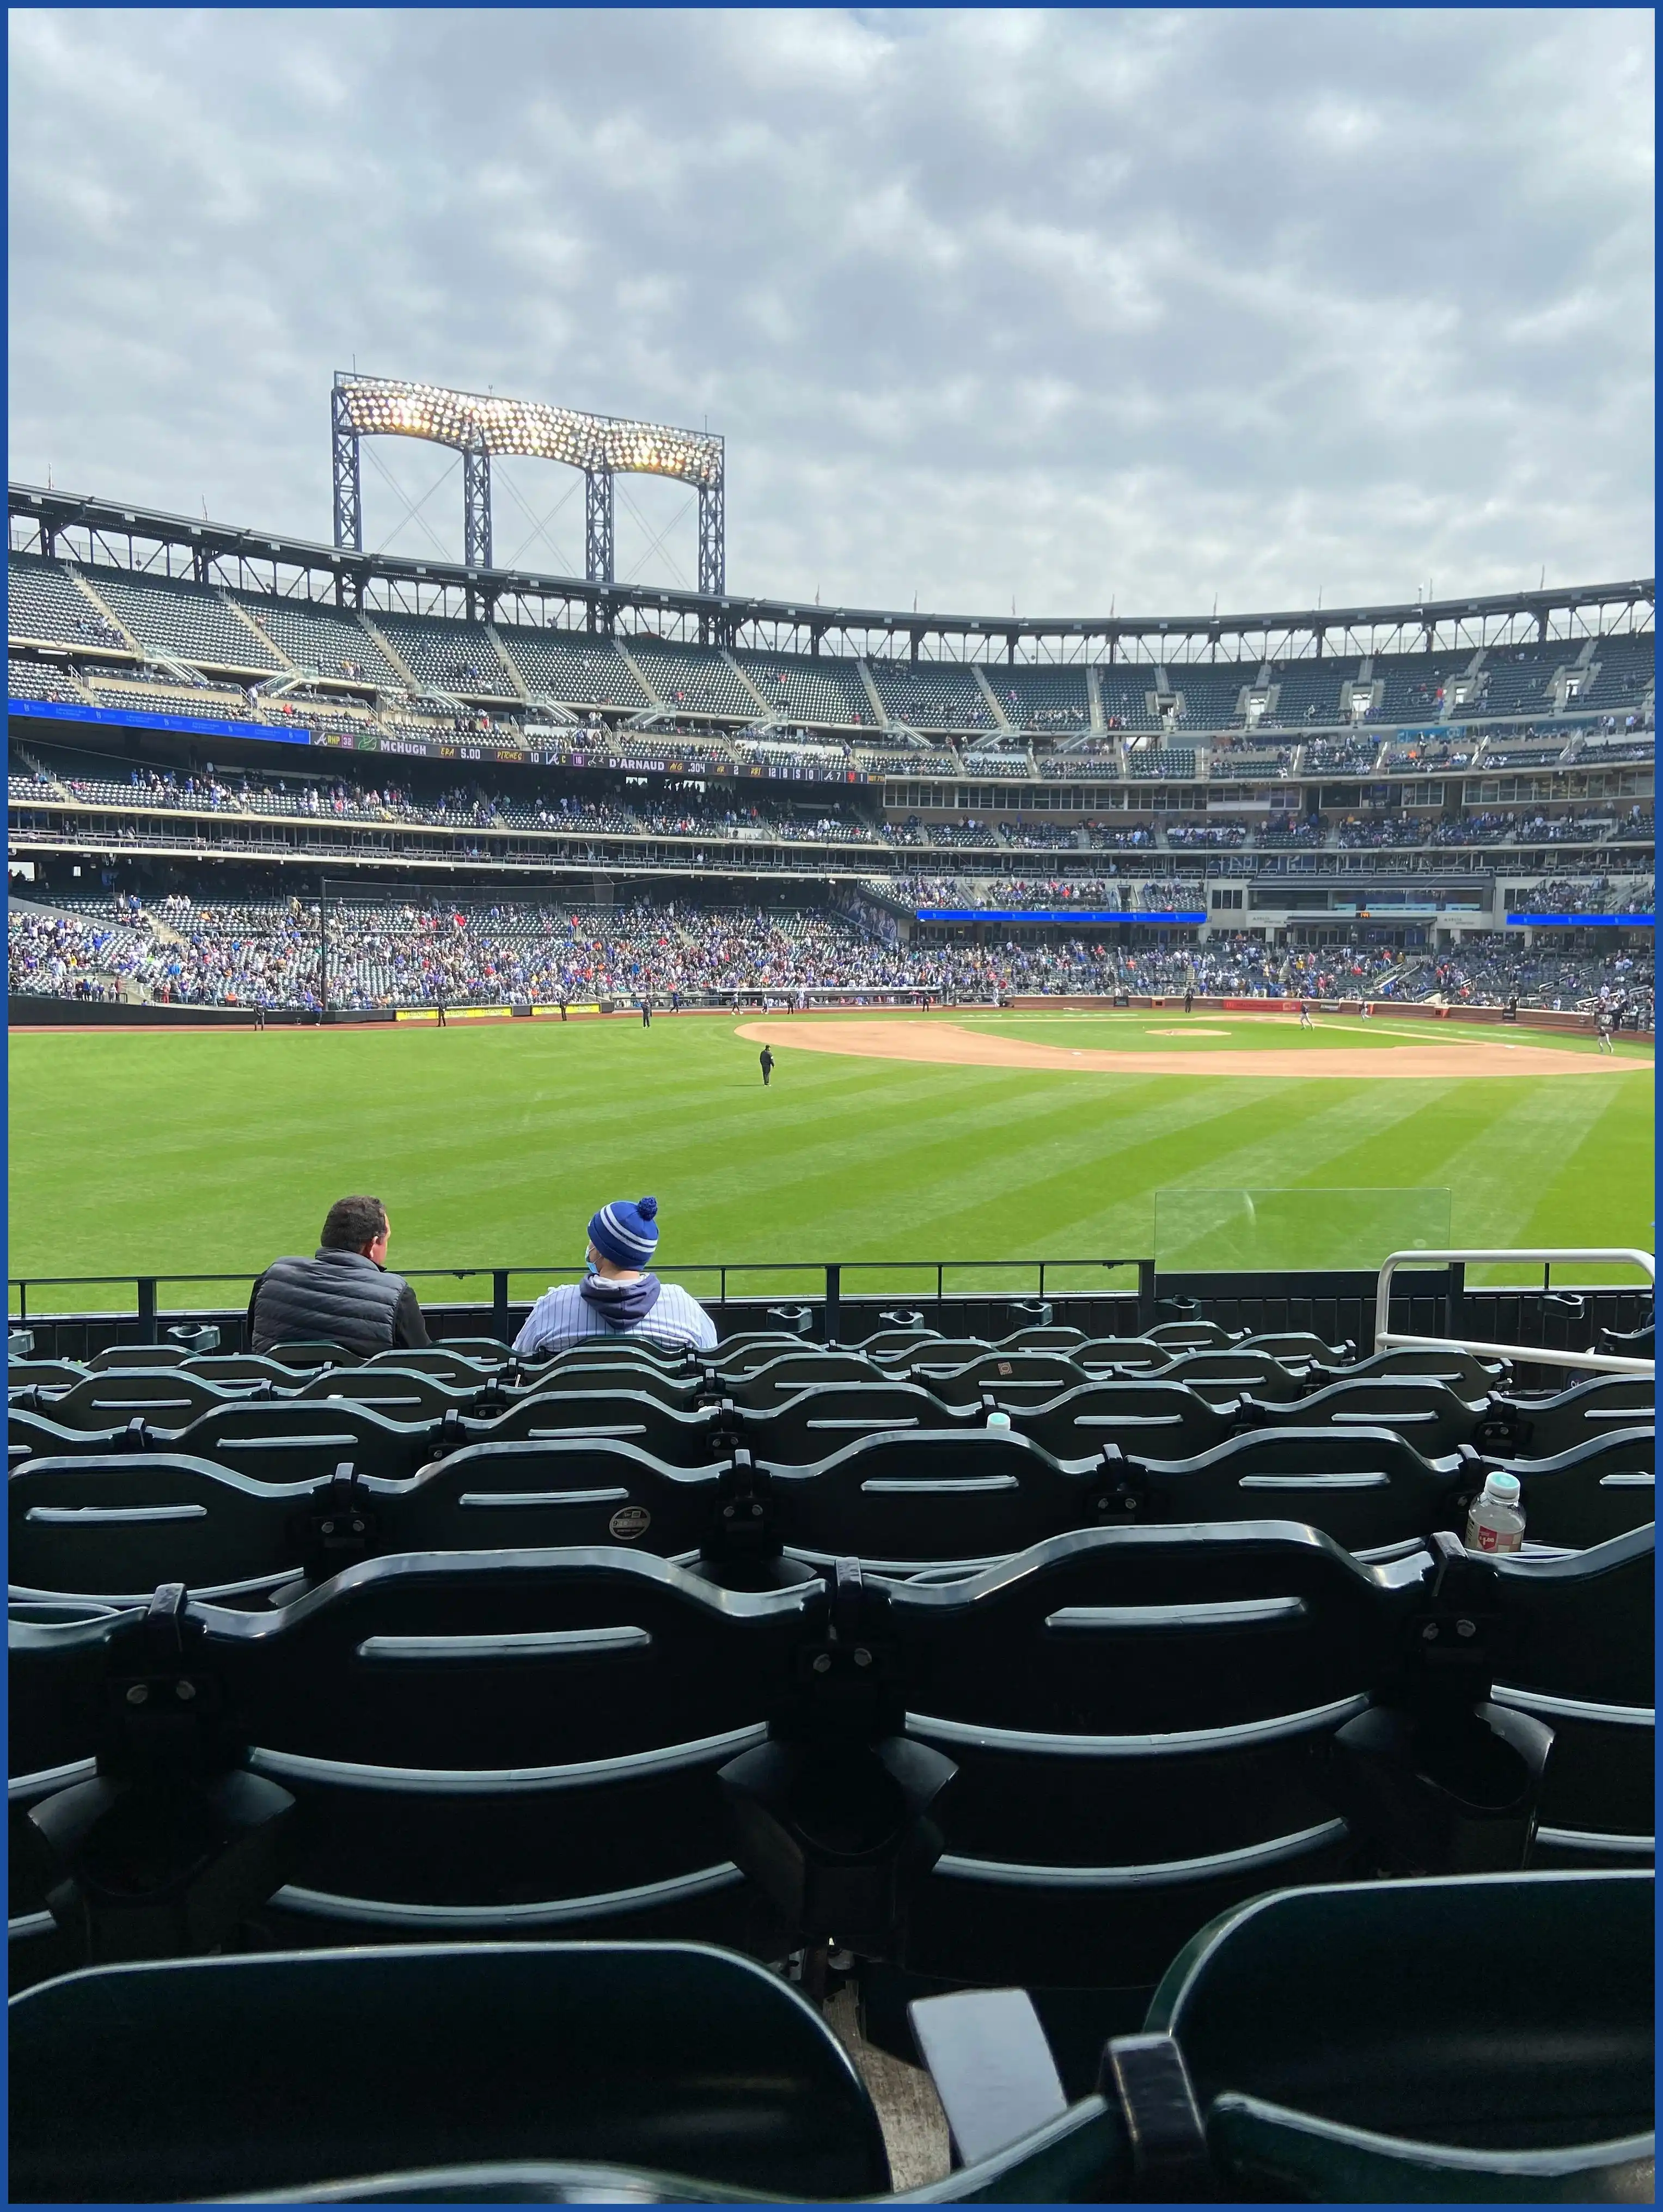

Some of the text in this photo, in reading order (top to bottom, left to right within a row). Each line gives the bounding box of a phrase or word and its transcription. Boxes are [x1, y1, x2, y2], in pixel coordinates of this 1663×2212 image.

[327, 735, 340, 745] RHP
[343, 737, 352, 746] 32
[441, 747, 455, 756] ERA
[461, 748, 481, 760] 5.00
[497, 751, 522, 761] PITCHES
[530, 753, 539, 763] 10
[609, 757, 665, 771] D'ARNAUD
[688, 762, 705, 773] .304
[733, 766, 739, 775] 2
[750, 767, 761, 775] RBI
[768, 767, 776, 777] 12
[782, 768, 788, 778] B
[795, 769, 801, 779] S
[836, 772, 841, 781] 7
